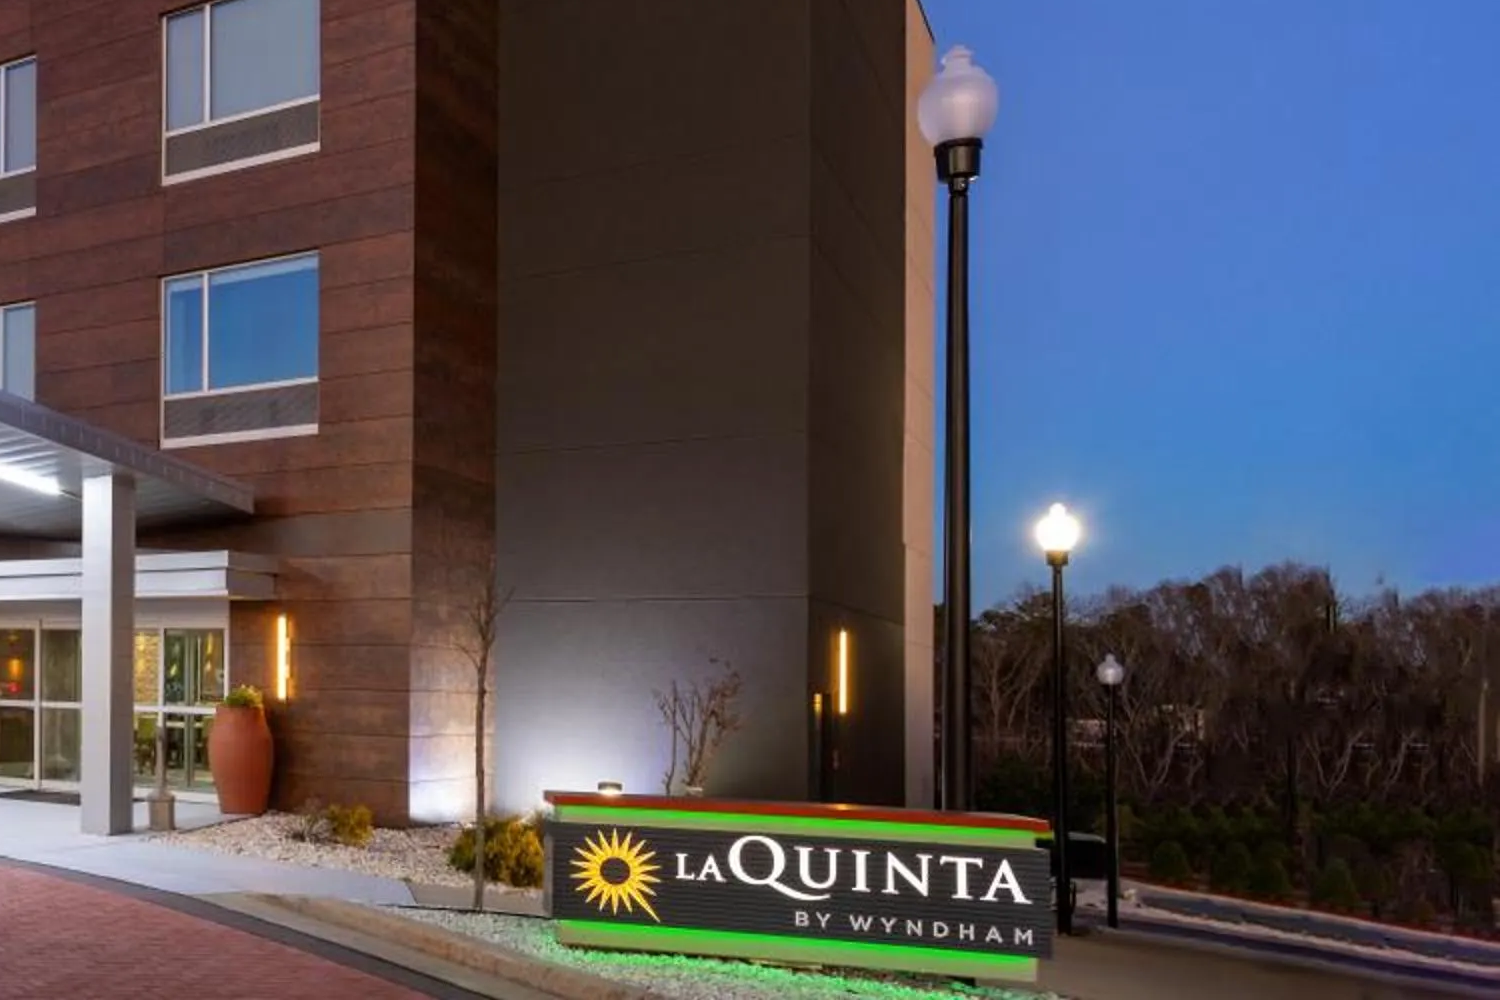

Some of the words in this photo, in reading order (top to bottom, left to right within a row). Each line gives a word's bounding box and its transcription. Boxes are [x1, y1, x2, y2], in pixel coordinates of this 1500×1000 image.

[675, 852, 726, 882] LA
[727, 835, 1033, 905] QUINTA
[795, 911, 831, 928] BY
[849, 914, 1035, 946] WYNDHAM
